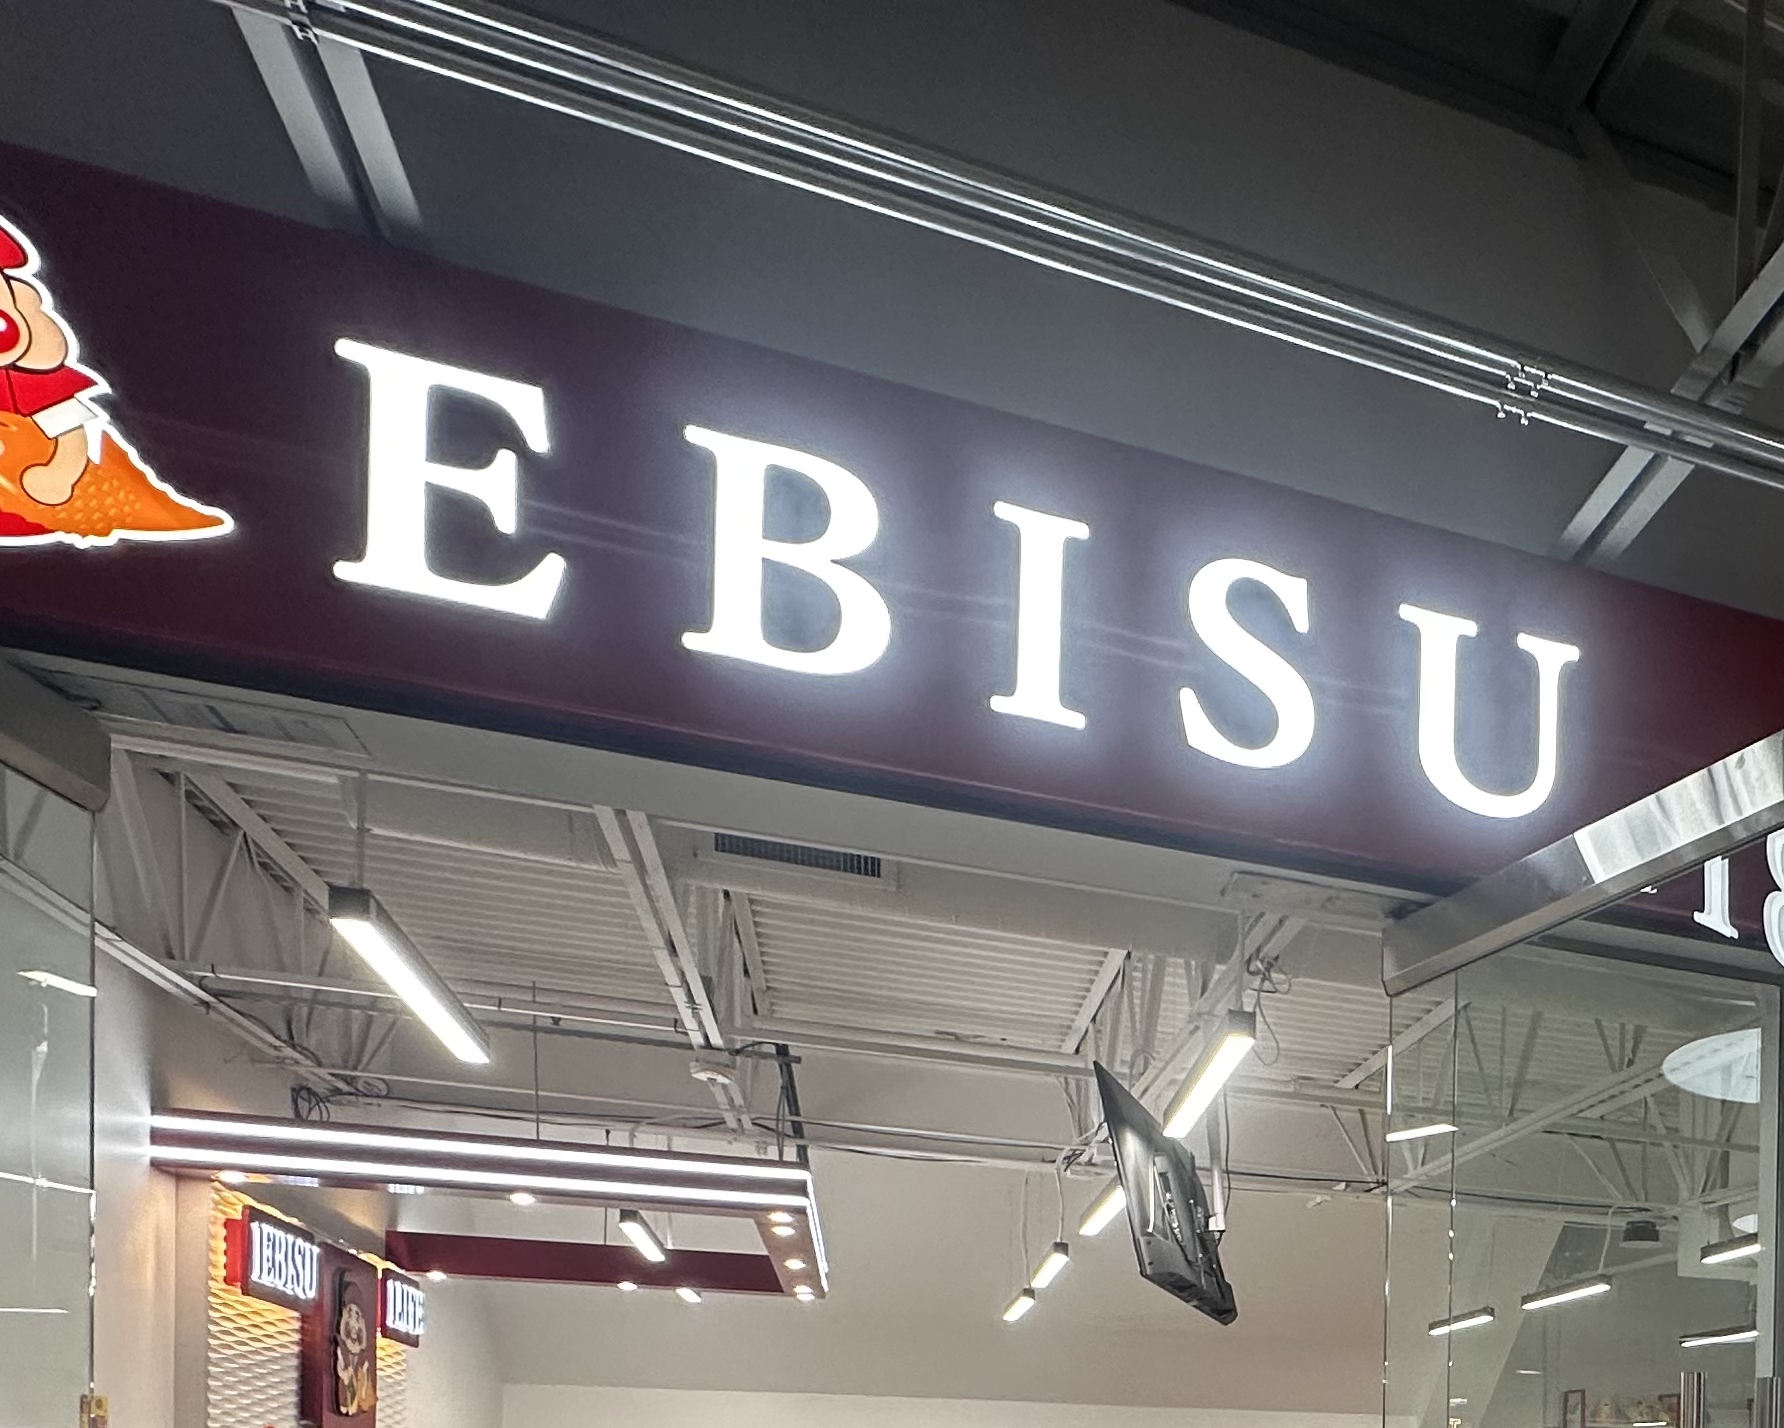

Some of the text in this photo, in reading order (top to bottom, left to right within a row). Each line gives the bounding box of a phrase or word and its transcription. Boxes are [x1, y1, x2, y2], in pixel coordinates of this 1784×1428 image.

[332, 338, 1582, 820] EBISU
[252, 1221, 320, 1299] EBISU
[388, 1280, 426, 1335] LIFE
